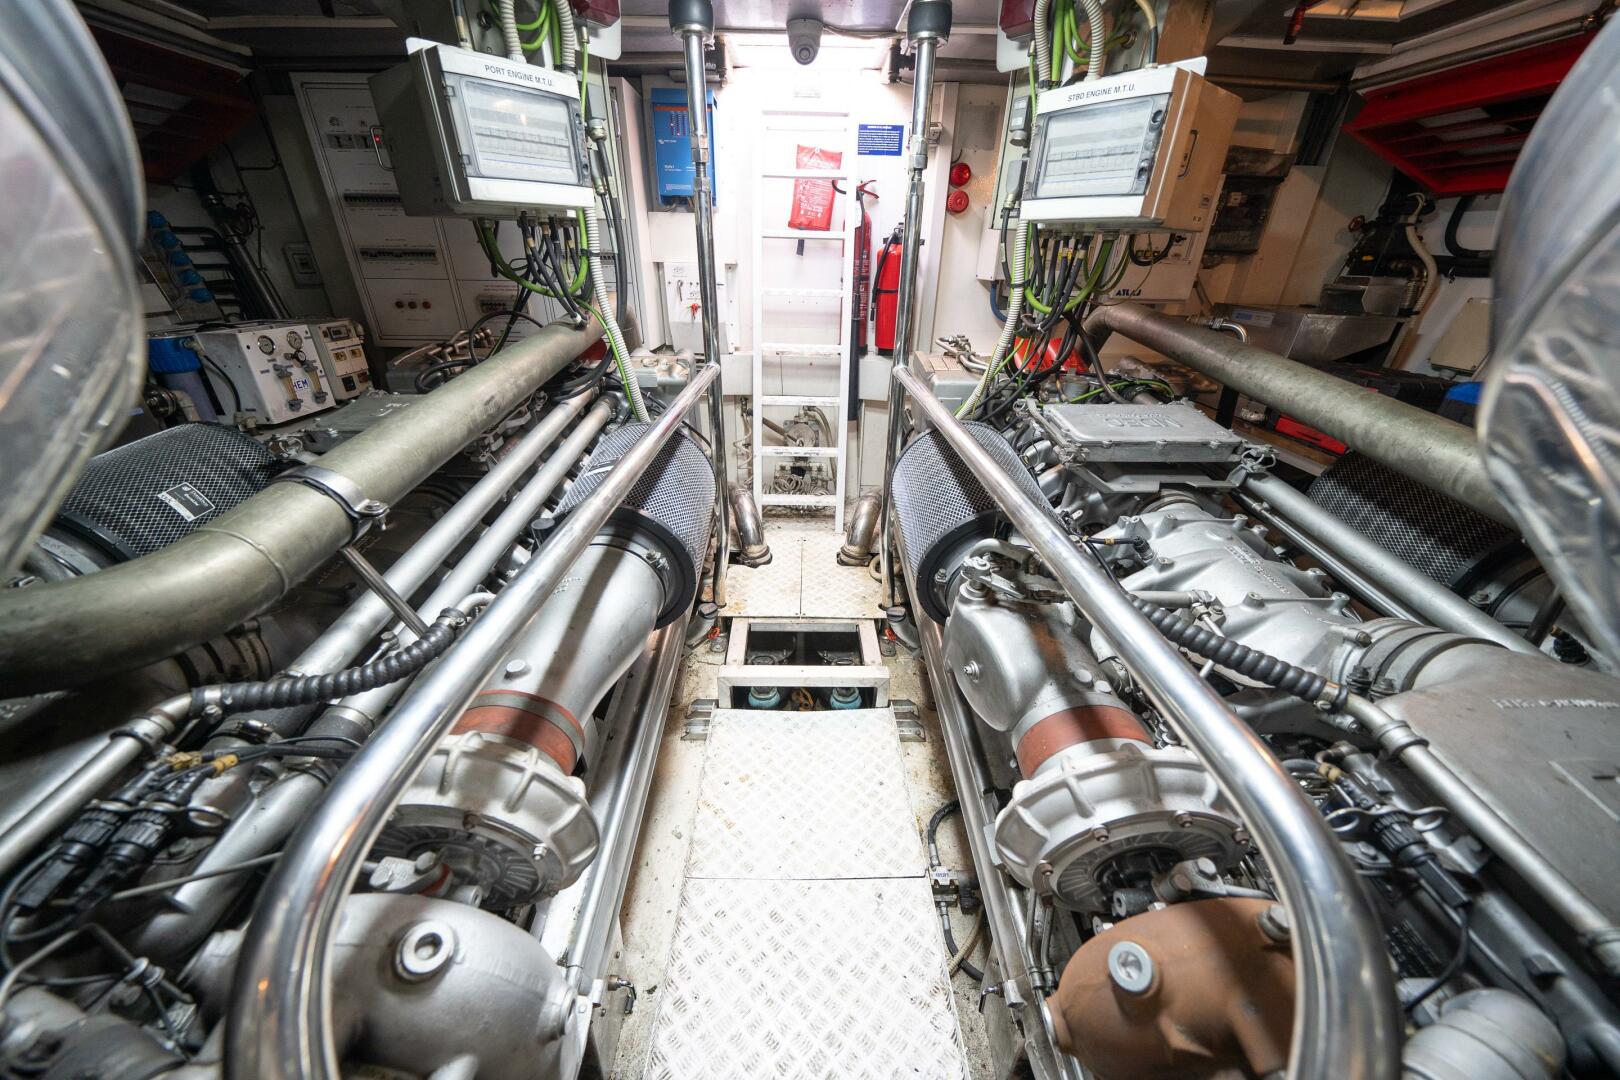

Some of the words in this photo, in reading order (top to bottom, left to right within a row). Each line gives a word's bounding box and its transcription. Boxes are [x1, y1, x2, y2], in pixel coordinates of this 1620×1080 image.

[484, 64, 505, 75] PORT
[508, 69, 534, 82] ENGINE
[1067, 92, 1085, 102] STBD
[1086, 87, 1112, 98] ENGINE
